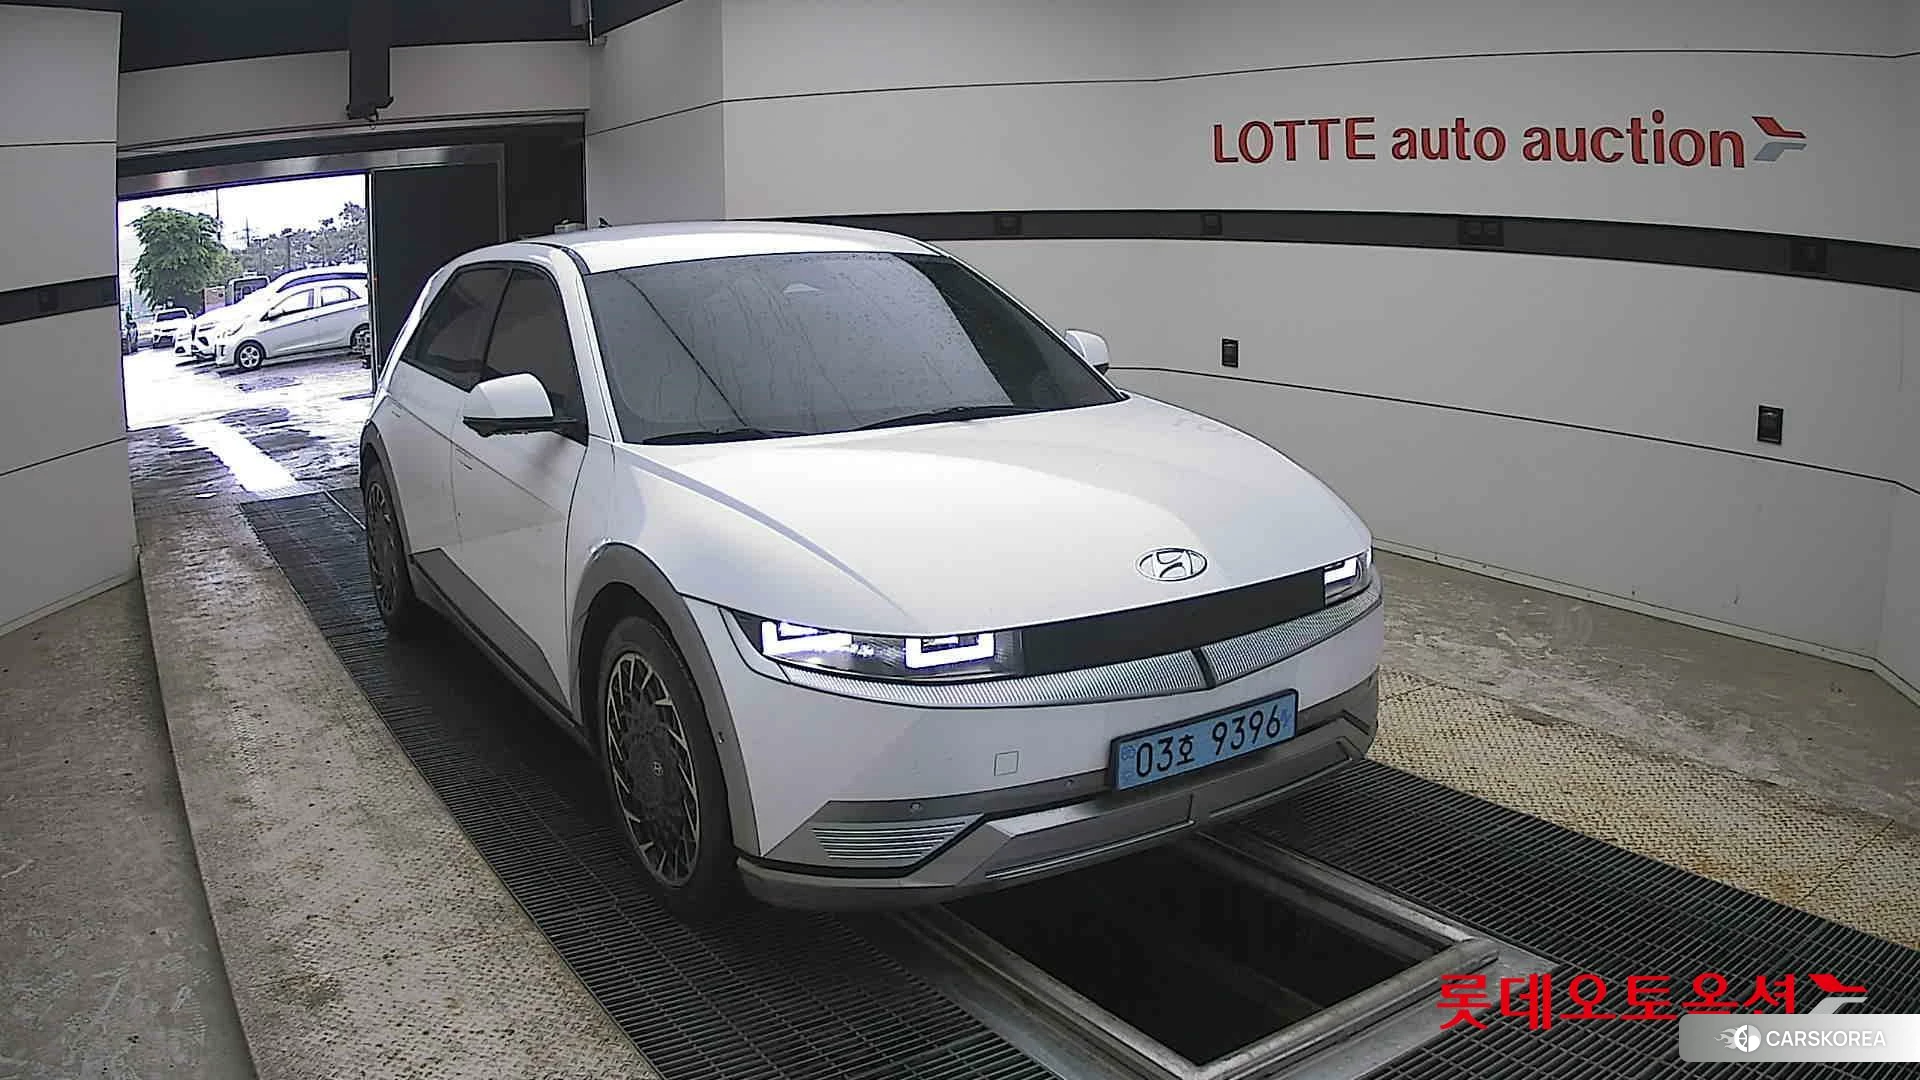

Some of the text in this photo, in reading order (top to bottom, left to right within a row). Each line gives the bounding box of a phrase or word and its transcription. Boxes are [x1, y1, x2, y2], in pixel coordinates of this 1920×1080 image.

[1212, 109, 1745, 169] LOTTE auto auction
[1135, 704, 1281, 778] 03호 9396
